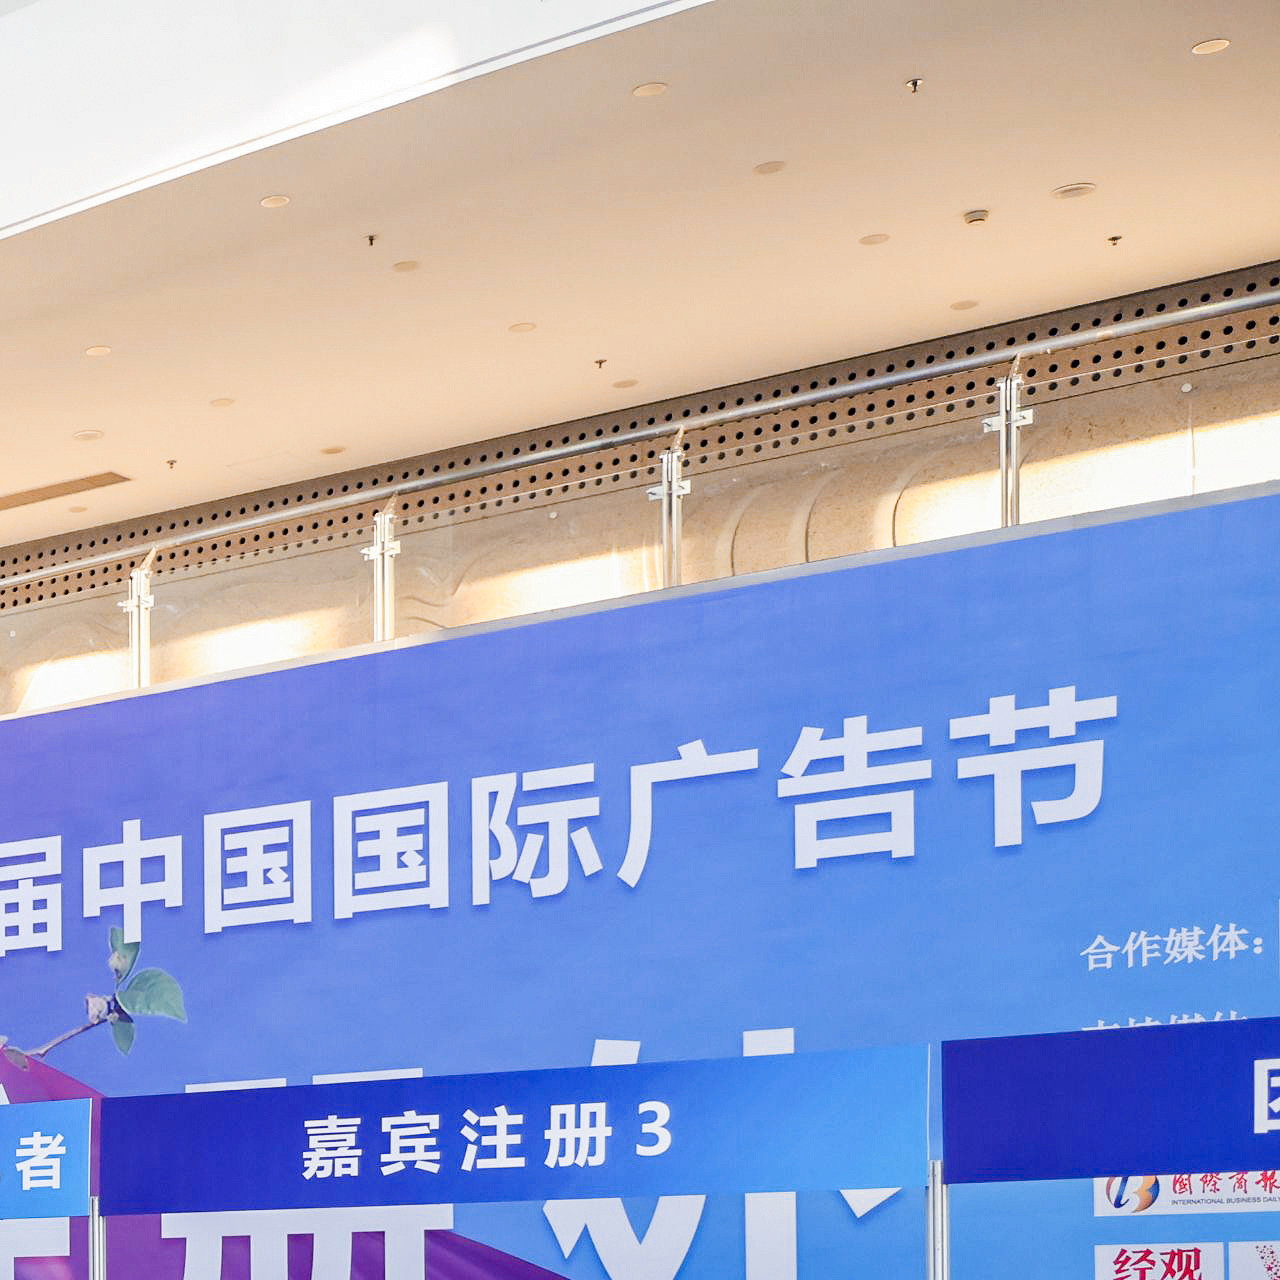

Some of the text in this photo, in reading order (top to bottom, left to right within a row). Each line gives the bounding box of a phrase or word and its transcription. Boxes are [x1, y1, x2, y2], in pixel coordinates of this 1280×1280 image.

[1080, 922, 1263, 972] 合作媒体：
[301, 1100, 674, 1181] 嘉宾注册3
